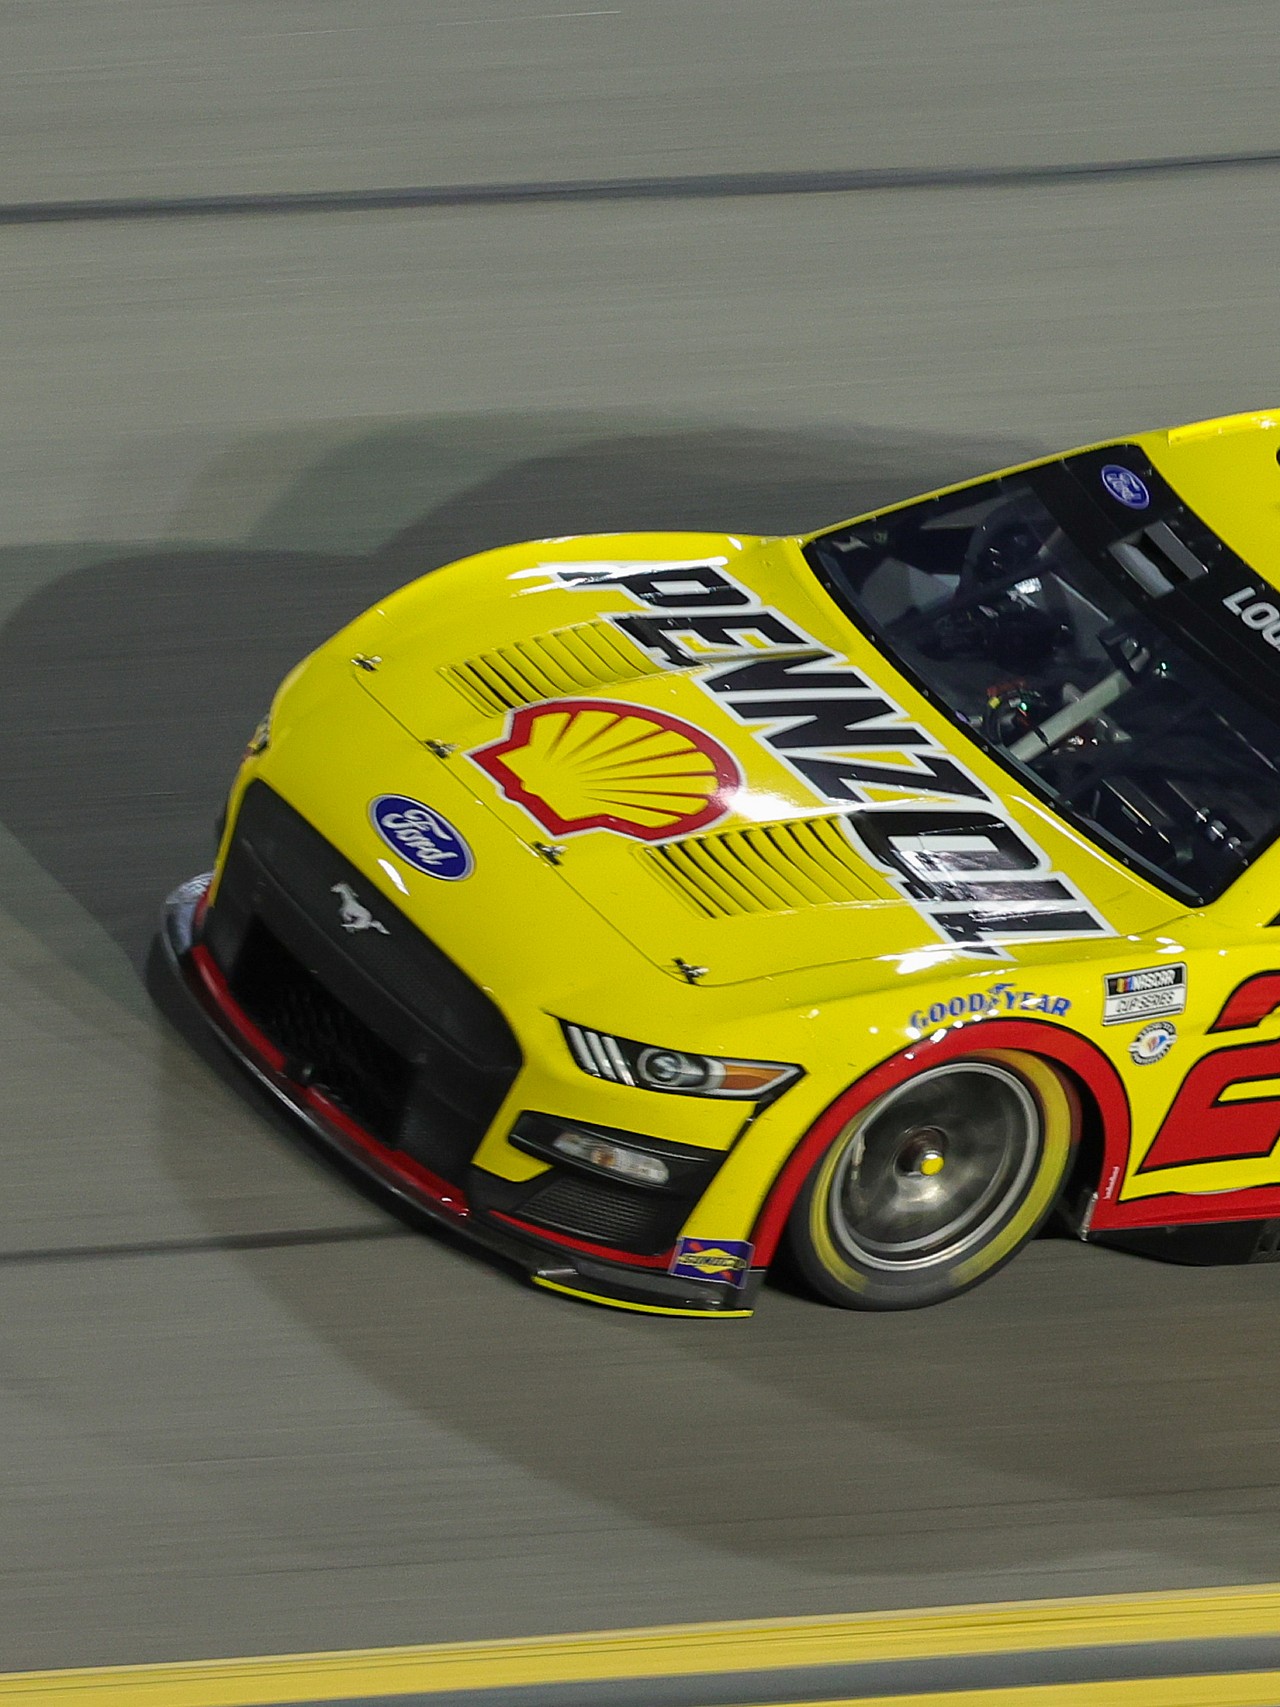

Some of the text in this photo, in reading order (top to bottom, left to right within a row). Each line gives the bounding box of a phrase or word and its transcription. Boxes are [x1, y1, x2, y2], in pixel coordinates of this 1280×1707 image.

[1104, 470, 1143, 503] Ford
[548, 562, 1116, 960] PENNZOIL
[380, 808, 459, 866] Ford
